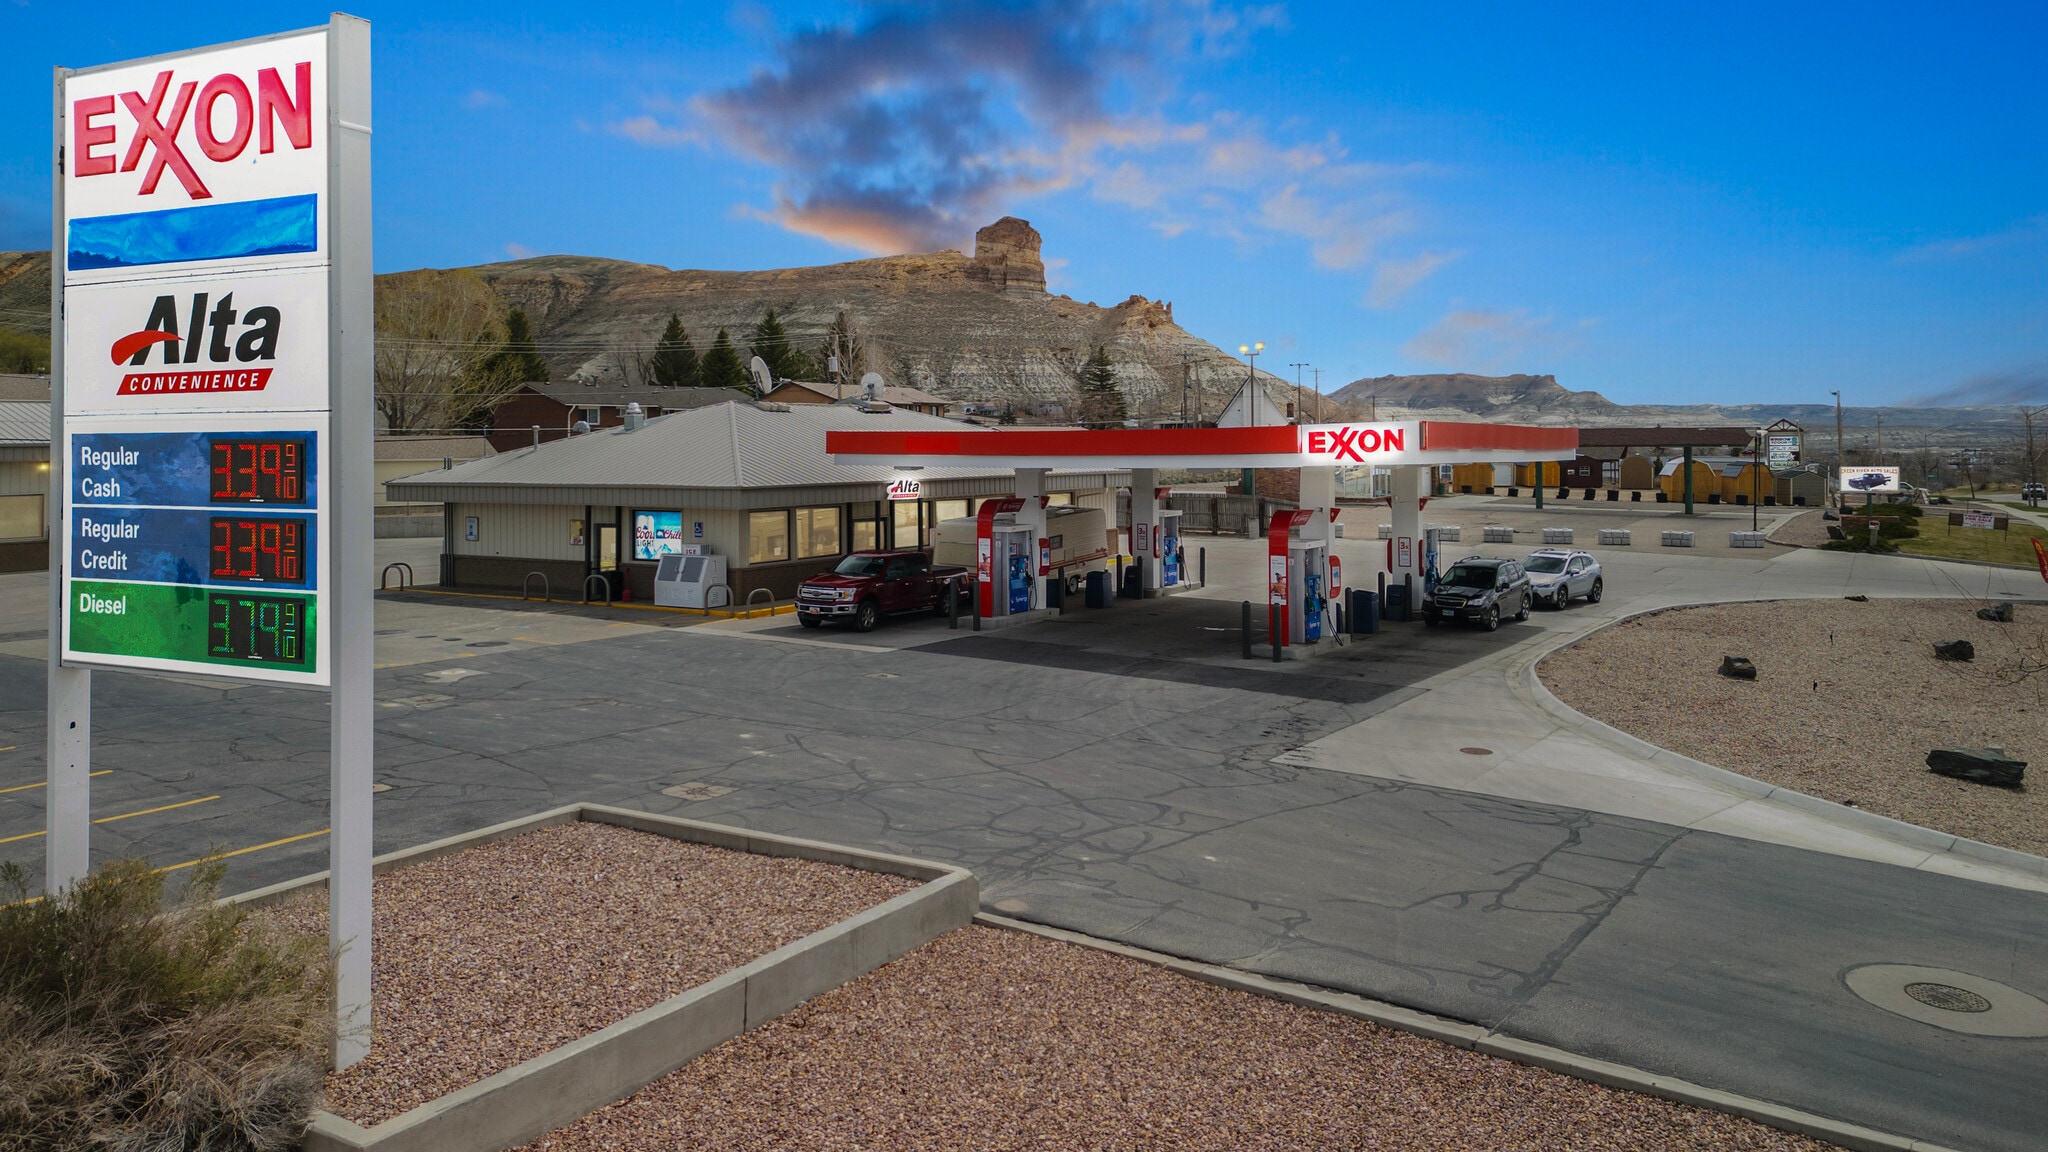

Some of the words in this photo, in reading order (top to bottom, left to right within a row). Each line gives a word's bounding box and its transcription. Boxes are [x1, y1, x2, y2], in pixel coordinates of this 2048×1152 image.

[74, 62, 311, 199] EXXON
[129, 291, 281, 366] Alta
[130, 373, 259, 391] CONVENIENCE
[1308, 427, 1404, 462] EXXON
[81, 446, 139, 470] Regular
[82, 478, 120, 497] Cash
[895, 480, 919, 493] Alta
[82, 518, 139, 542] Regular
[81, 549, 127, 570] Credit
[80, 593, 126, 615] Diesel
